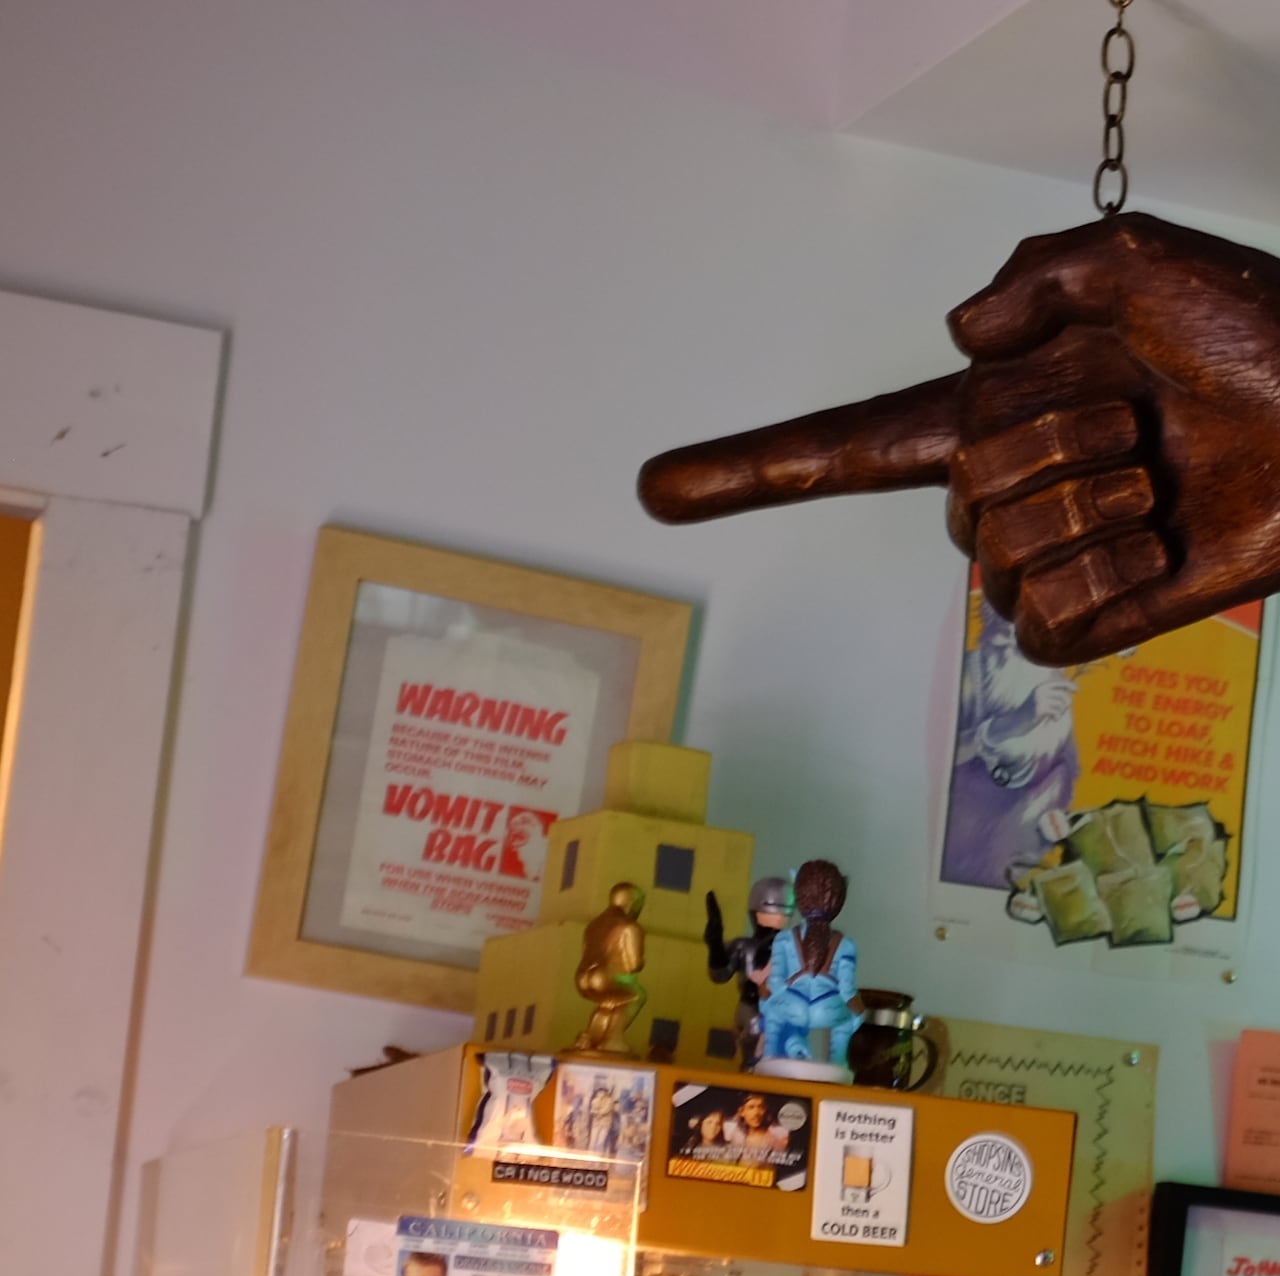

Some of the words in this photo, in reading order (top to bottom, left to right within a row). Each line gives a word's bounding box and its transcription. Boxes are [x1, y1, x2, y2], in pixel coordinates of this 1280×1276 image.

[1120, 663, 1180, 689] GIVES
[1184, 674, 1229, 698] YOU
[395, 681, 570, 746] WARNING
[1111, 685, 1147, 709] THE
[1151, 694, 1233, 721] ENERGY
[392, 723, 450, 742] BECAUSE
[1125, 713, 1151, 734] TO
[1096, 733, 1159, 759] HITCH
[1165, 745, 1217, 769] HIKE
[1091, 756, 1158, 783] AVOID
[1161, 768, 1231, 793] WORK
[382, 783, 504, 834] VOMIT
[422, 829, 498, 872] BAG
[835, 1111, 896, 1130] Nothing
[835, 1128, 845, 1139] is
[850, 1129, 896, 1144] better
[841, 1206, 869, 1218] then
[872, 1209, 880, 1218] a
[956, 1180, 1014, 1217] STORE
[409, 1221, 547, 1247] CALIFORNIA
[821, 1221, 858, 1237] COLD
[862, 1226, 898, 1240] BEER
